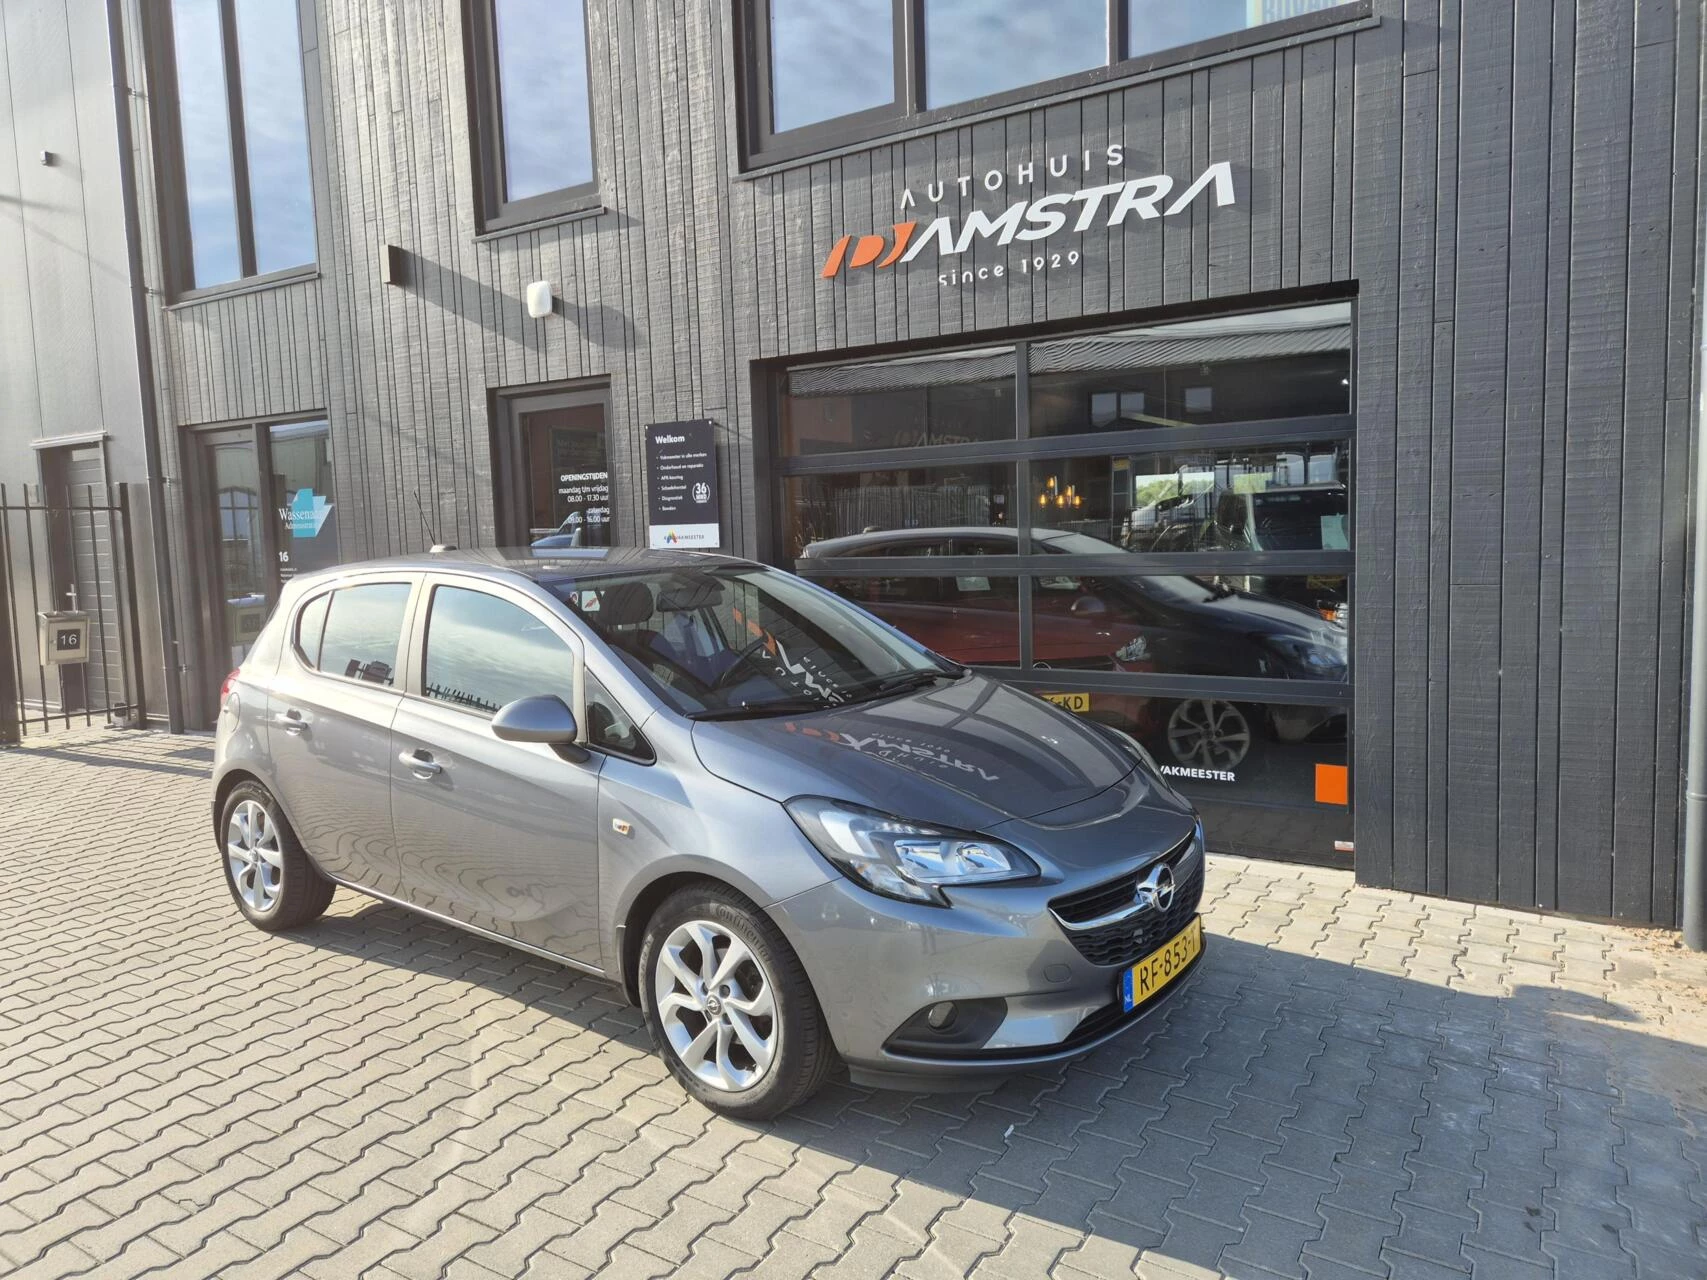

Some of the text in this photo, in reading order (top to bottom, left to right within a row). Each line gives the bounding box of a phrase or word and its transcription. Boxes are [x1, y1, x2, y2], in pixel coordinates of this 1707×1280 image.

[900, 144, 1125, 209] AUTOHUIS
[938, 251, 1080, 287] since 1929
[655, 434, 686, 444] Welkom
[560, 471, 608, 482] OPENINGSTIJDEN
[558, 485, 581, 495] maandag
[591, 484, 609, 495] vrijdag
[695, 482, 707, 494] 36
[586, 494, 600, 502] 17.30
[278, 551, 289, 562] 16
[60, 634, 77, 645] 16
